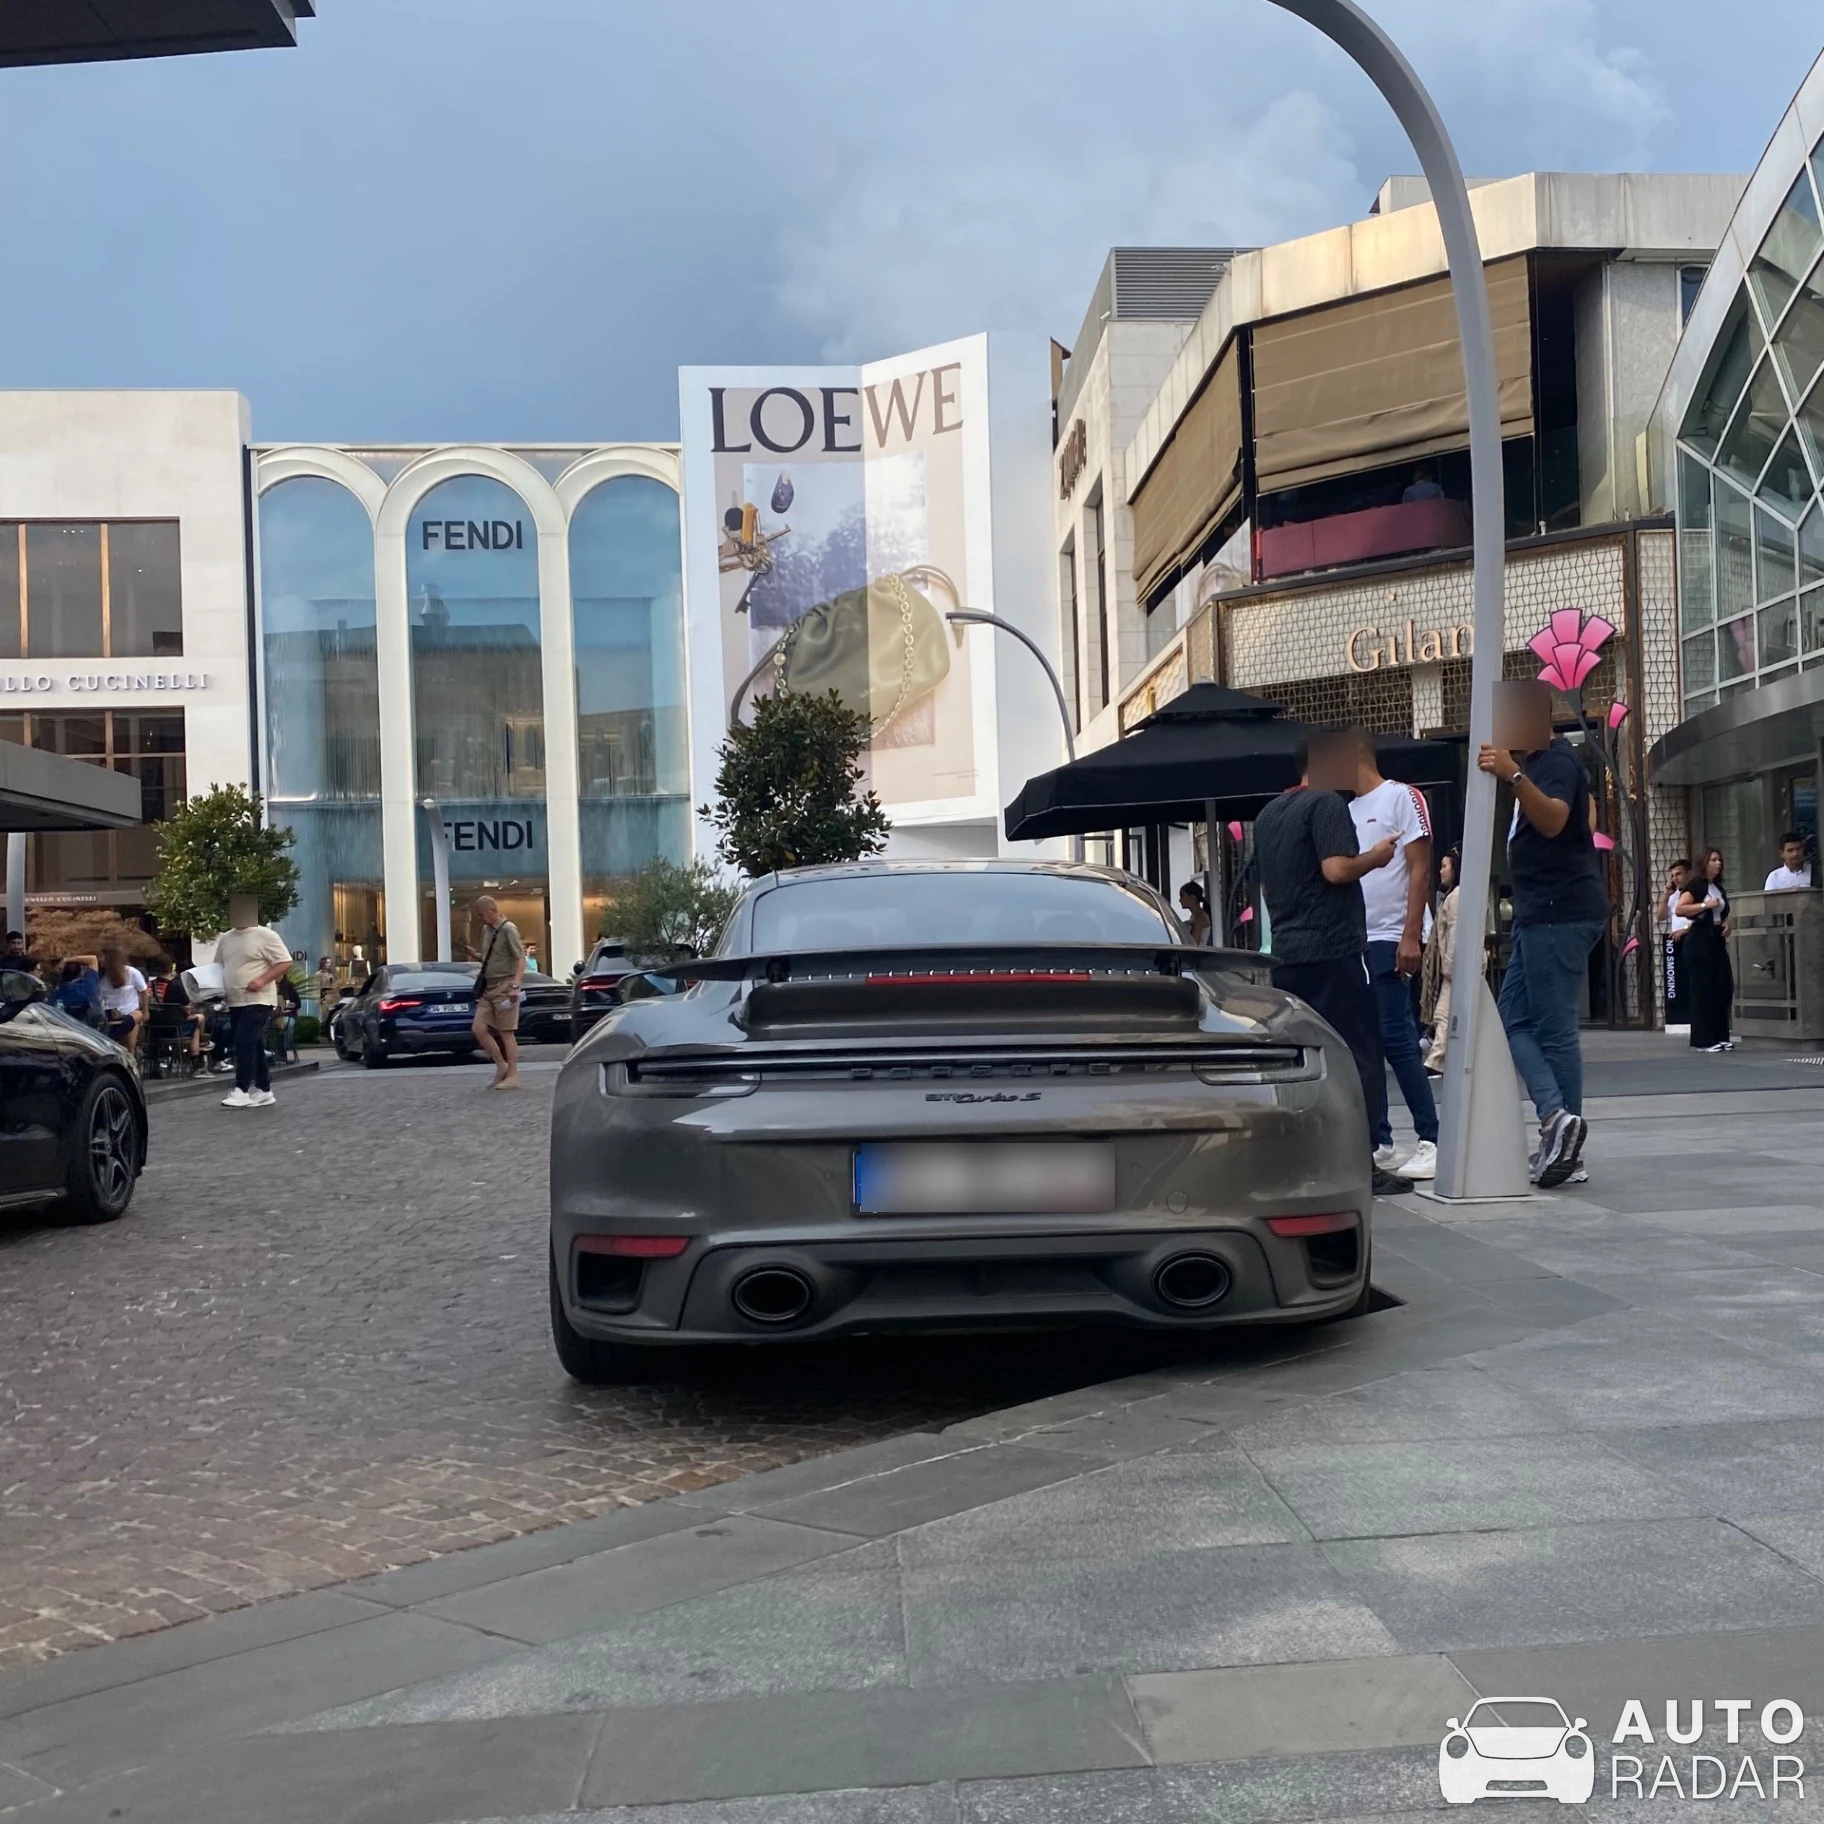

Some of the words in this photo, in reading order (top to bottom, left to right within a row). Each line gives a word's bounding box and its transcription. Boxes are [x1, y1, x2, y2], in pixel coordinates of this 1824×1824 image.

[707, 361, 964, 453] LOEWE
[422, 520, 523, 550] FENDI
[1345, 593, 1475, 673] Gilan
[2, 675, 52, 692] LLO
[67, 673, 207, 691] CUCINELLI
[290, 950, 308, 961] NDI
[1665, 939, 1674, 954] NO
[1666, 955, 1676, 999] SMOKING
